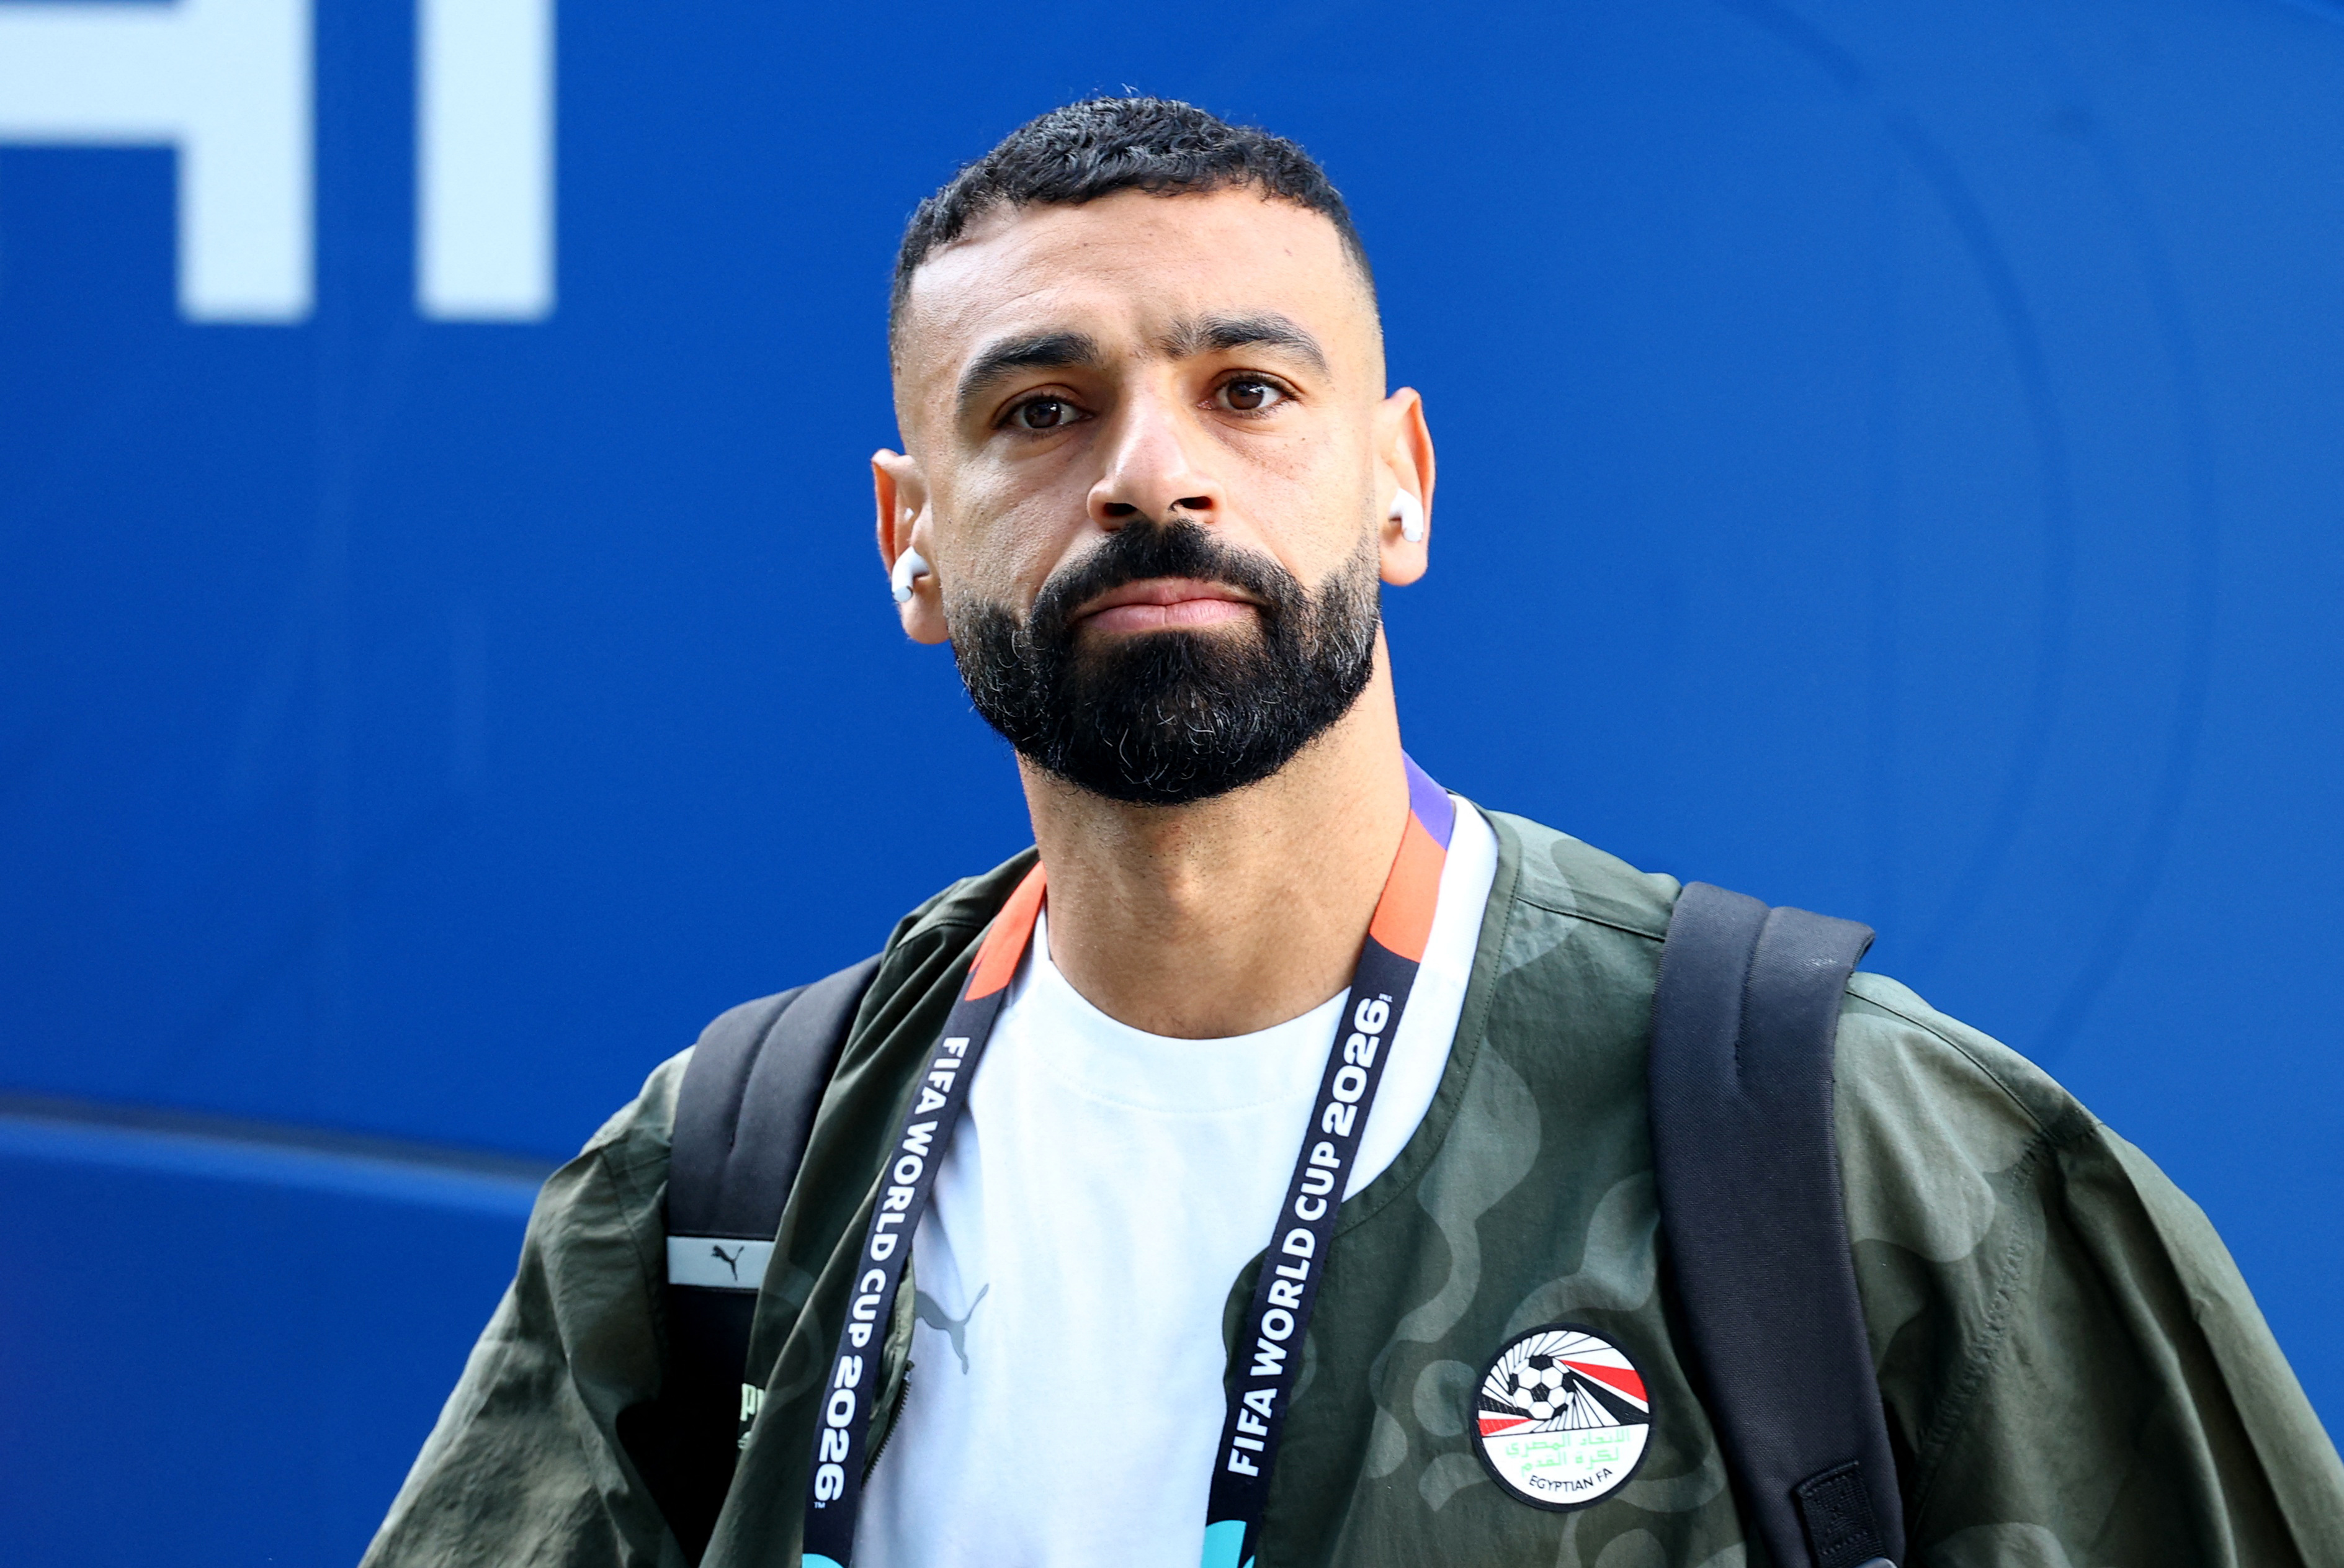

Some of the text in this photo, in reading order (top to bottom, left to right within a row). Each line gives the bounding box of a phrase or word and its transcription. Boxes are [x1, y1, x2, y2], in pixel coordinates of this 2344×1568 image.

[915, 1037, 970, 1114] FIFA
[870, 1121, 938, 1261] WORLD
[1295, 1141, 1341, 1221] CUP
[848, 1268, 886, 1348] CUP
[1250, 1228, 1315, 1376] WORLD
[1228, 1388, 1277, 1477] FIFA
[1529, 1468, 1613, 1492] EGYPTIAN FA
